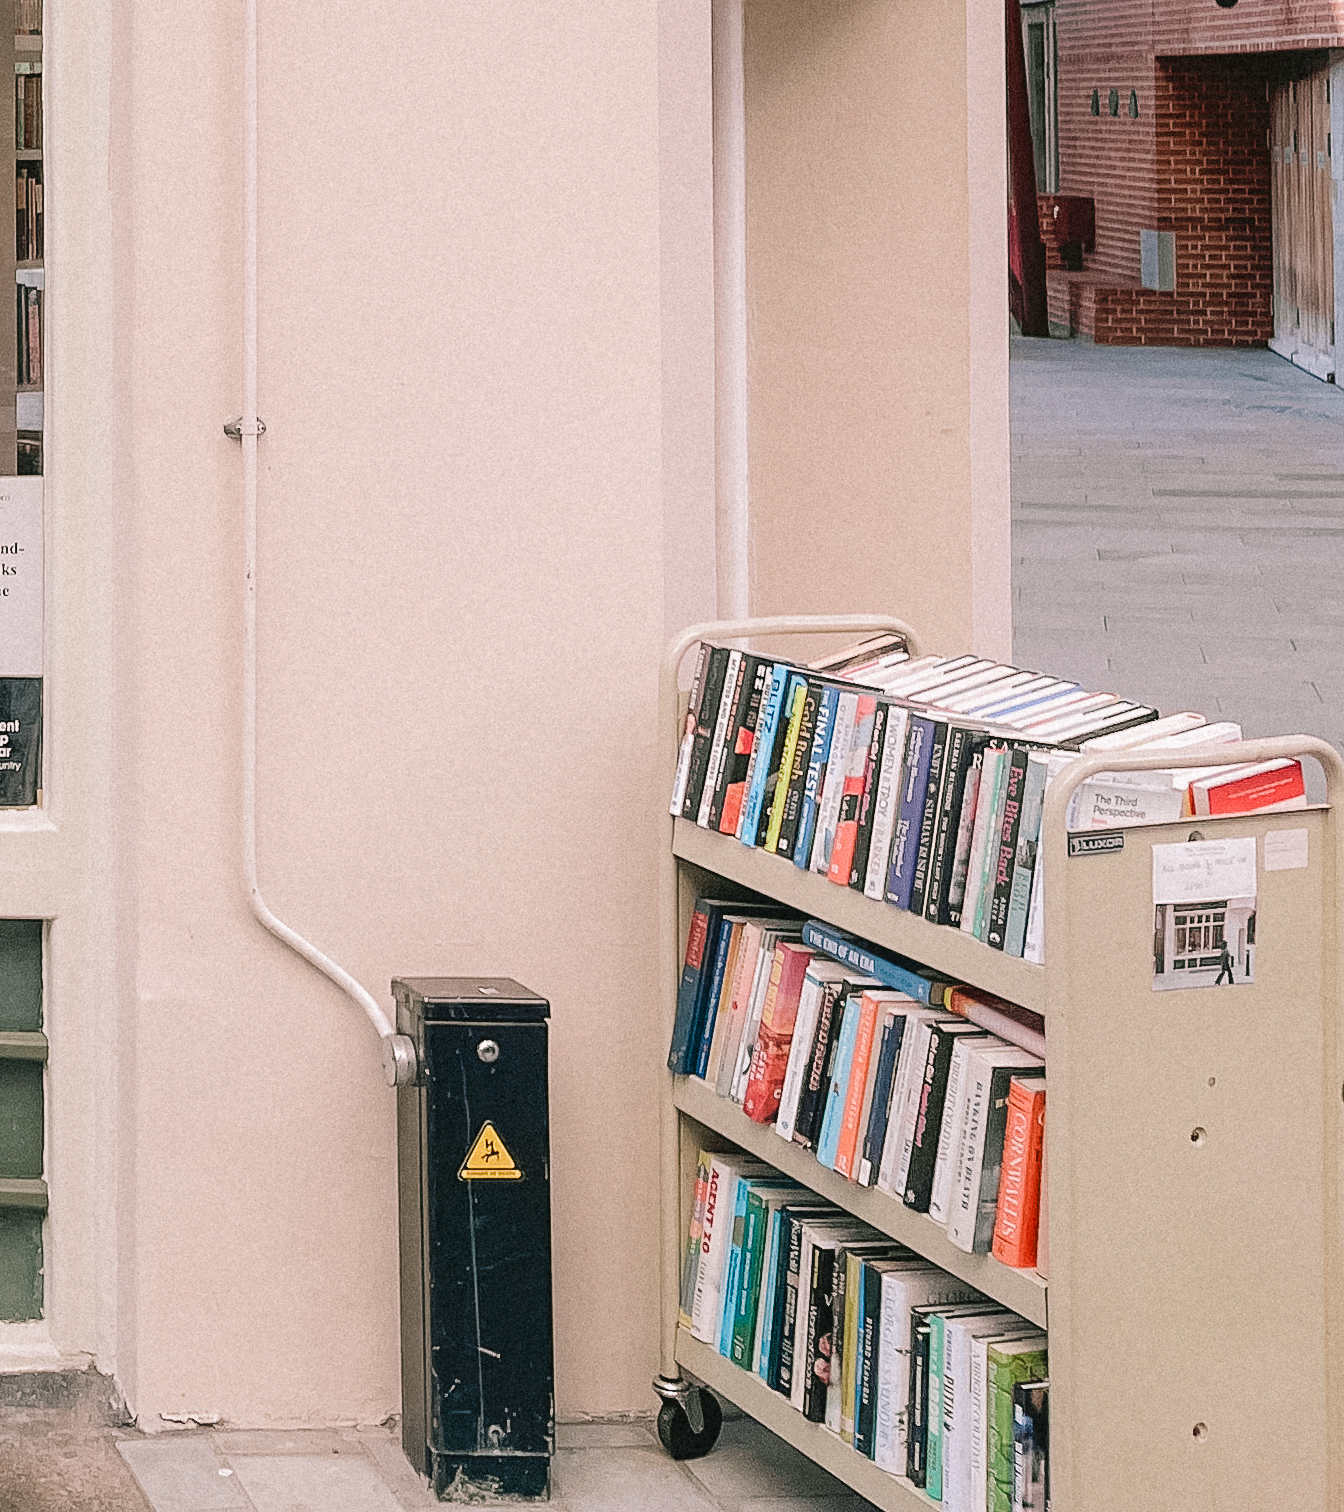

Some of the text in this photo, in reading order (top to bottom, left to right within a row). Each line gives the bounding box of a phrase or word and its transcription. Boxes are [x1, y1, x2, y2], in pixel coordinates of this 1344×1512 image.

[765, 678, 781, 734] BLITZ
[799, 696, 816, 738] Gold
[811, 706, 830, 760] FINAL
[804, 761, 822, 800] TEST
[870, 723, 899, 876] WOMEN TROY BARKER
[1095, 793, 1138, 807] The Third
[919, 799, 934, 843] SALMAN
[995, 766, 1023, 887] Eve Bites Back
[1093, 804, 1147, 819] Perspective
[1081, 837, 1124, 850] LUXOR
[809, 929, 875, 974] THE END OF AN ERA
[967, 1145, 975, 1162] ON
[1000, 1112, 1028, 1236] CORNWALLIS
[705, 1167, 720, 1228] AGENT
[961, 1166, 972, 1211] DEATH
[883, 1285, 895, 1349] GEORGE
[943, 1374, 955, 1420] PUTIN
[972, 1359, 981, 1405] BRIGHT
